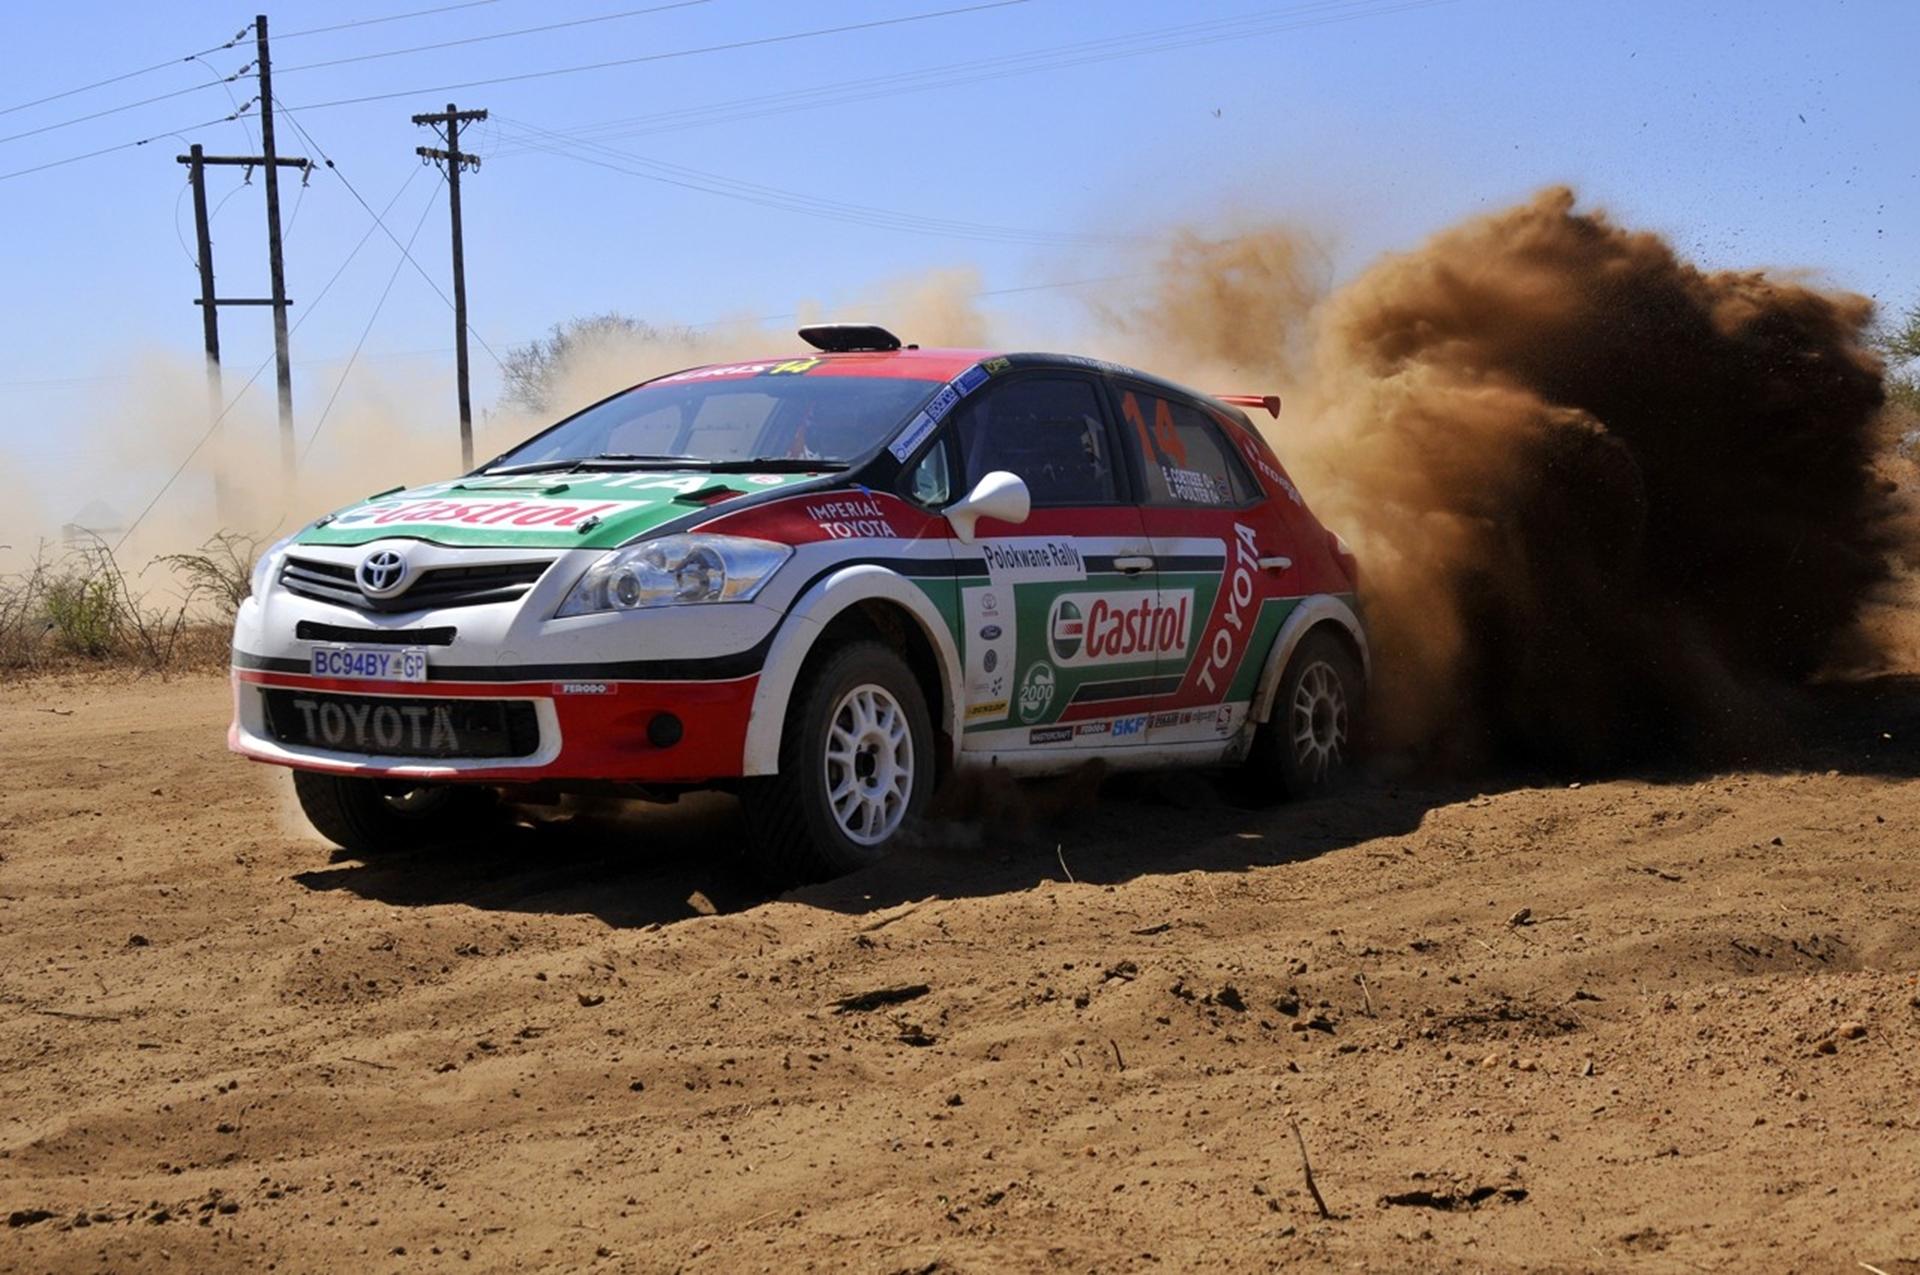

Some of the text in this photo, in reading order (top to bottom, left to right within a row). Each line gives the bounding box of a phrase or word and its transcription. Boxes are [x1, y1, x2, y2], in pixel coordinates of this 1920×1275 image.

[1122, 390, 1189, 469] 14
[376, 500, 620, 527] Castrol
[806, 501, 884, 521] IMPERIAL
[820, 520, 897, 539] TOYOTA
[982, 543, 1082, 572] Polokwane Rally
[1196, 521, 1259, 693] TOYOTA
[1086, 597, 1187, 658] Castrol
[314, 651, 424, 678] BC94BY GP
[563, 684, 606, 694] FERODO
[1021, 685, 1055, 701] 2000
[293, 699, 460, 751] TOYOTA
[1112, 716, 1149, 737] SKF
